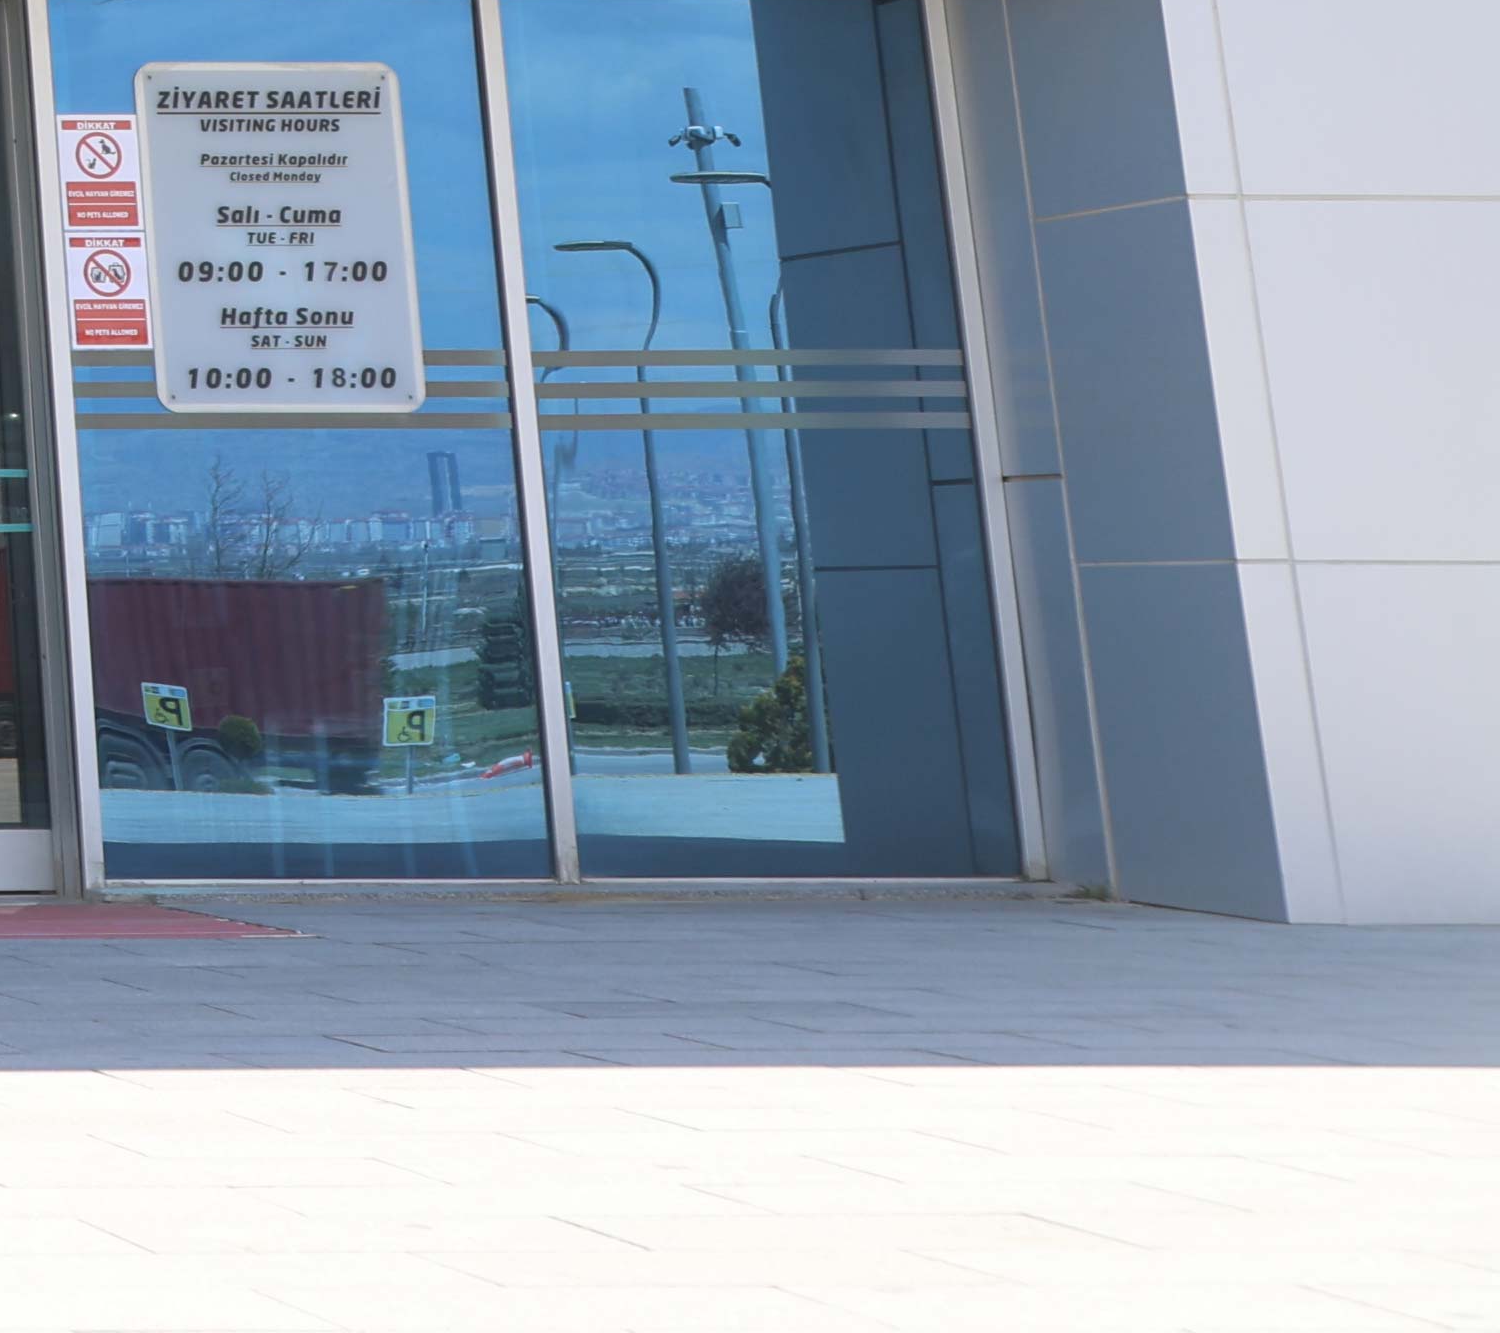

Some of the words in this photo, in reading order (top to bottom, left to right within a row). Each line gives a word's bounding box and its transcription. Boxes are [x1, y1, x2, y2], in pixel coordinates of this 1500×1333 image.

[156, 86, 259, 109] ZİYARET
[266, 86, 381, 109] SAATLERİ
[76, 120, 116, 130] DİKKAT
[200, 118, 276, 132] VISITING
[281, 118, 340, 132] HOURS
[200, 153, 274, 166] Pazartesi
[278, 153, 348, 167] Kapalıdır
[230, 171, 270, 182] Closed
[273, 171, 321, 183] Monday
[217, 206, 259, 224] Salı
[279, 206, 341, 224] Cuma
[85, 238, 125, 247] DİKKAT
[247, 232, 276, 244] TUE
[289, 232, 315, 244] FRI
[178, 261, 263, 282] 09:00
[304, 261, 387, 282] 17:00
[221, 307, 288, 329] Hafta
[296, 307, 354, 325] Sonu
[251, 335, 281, 347] SAT
[295, 335, 327, 347] SUN
[188, 367, 272, 389] 10:00
[314, 367, 396, 389] 18:00
